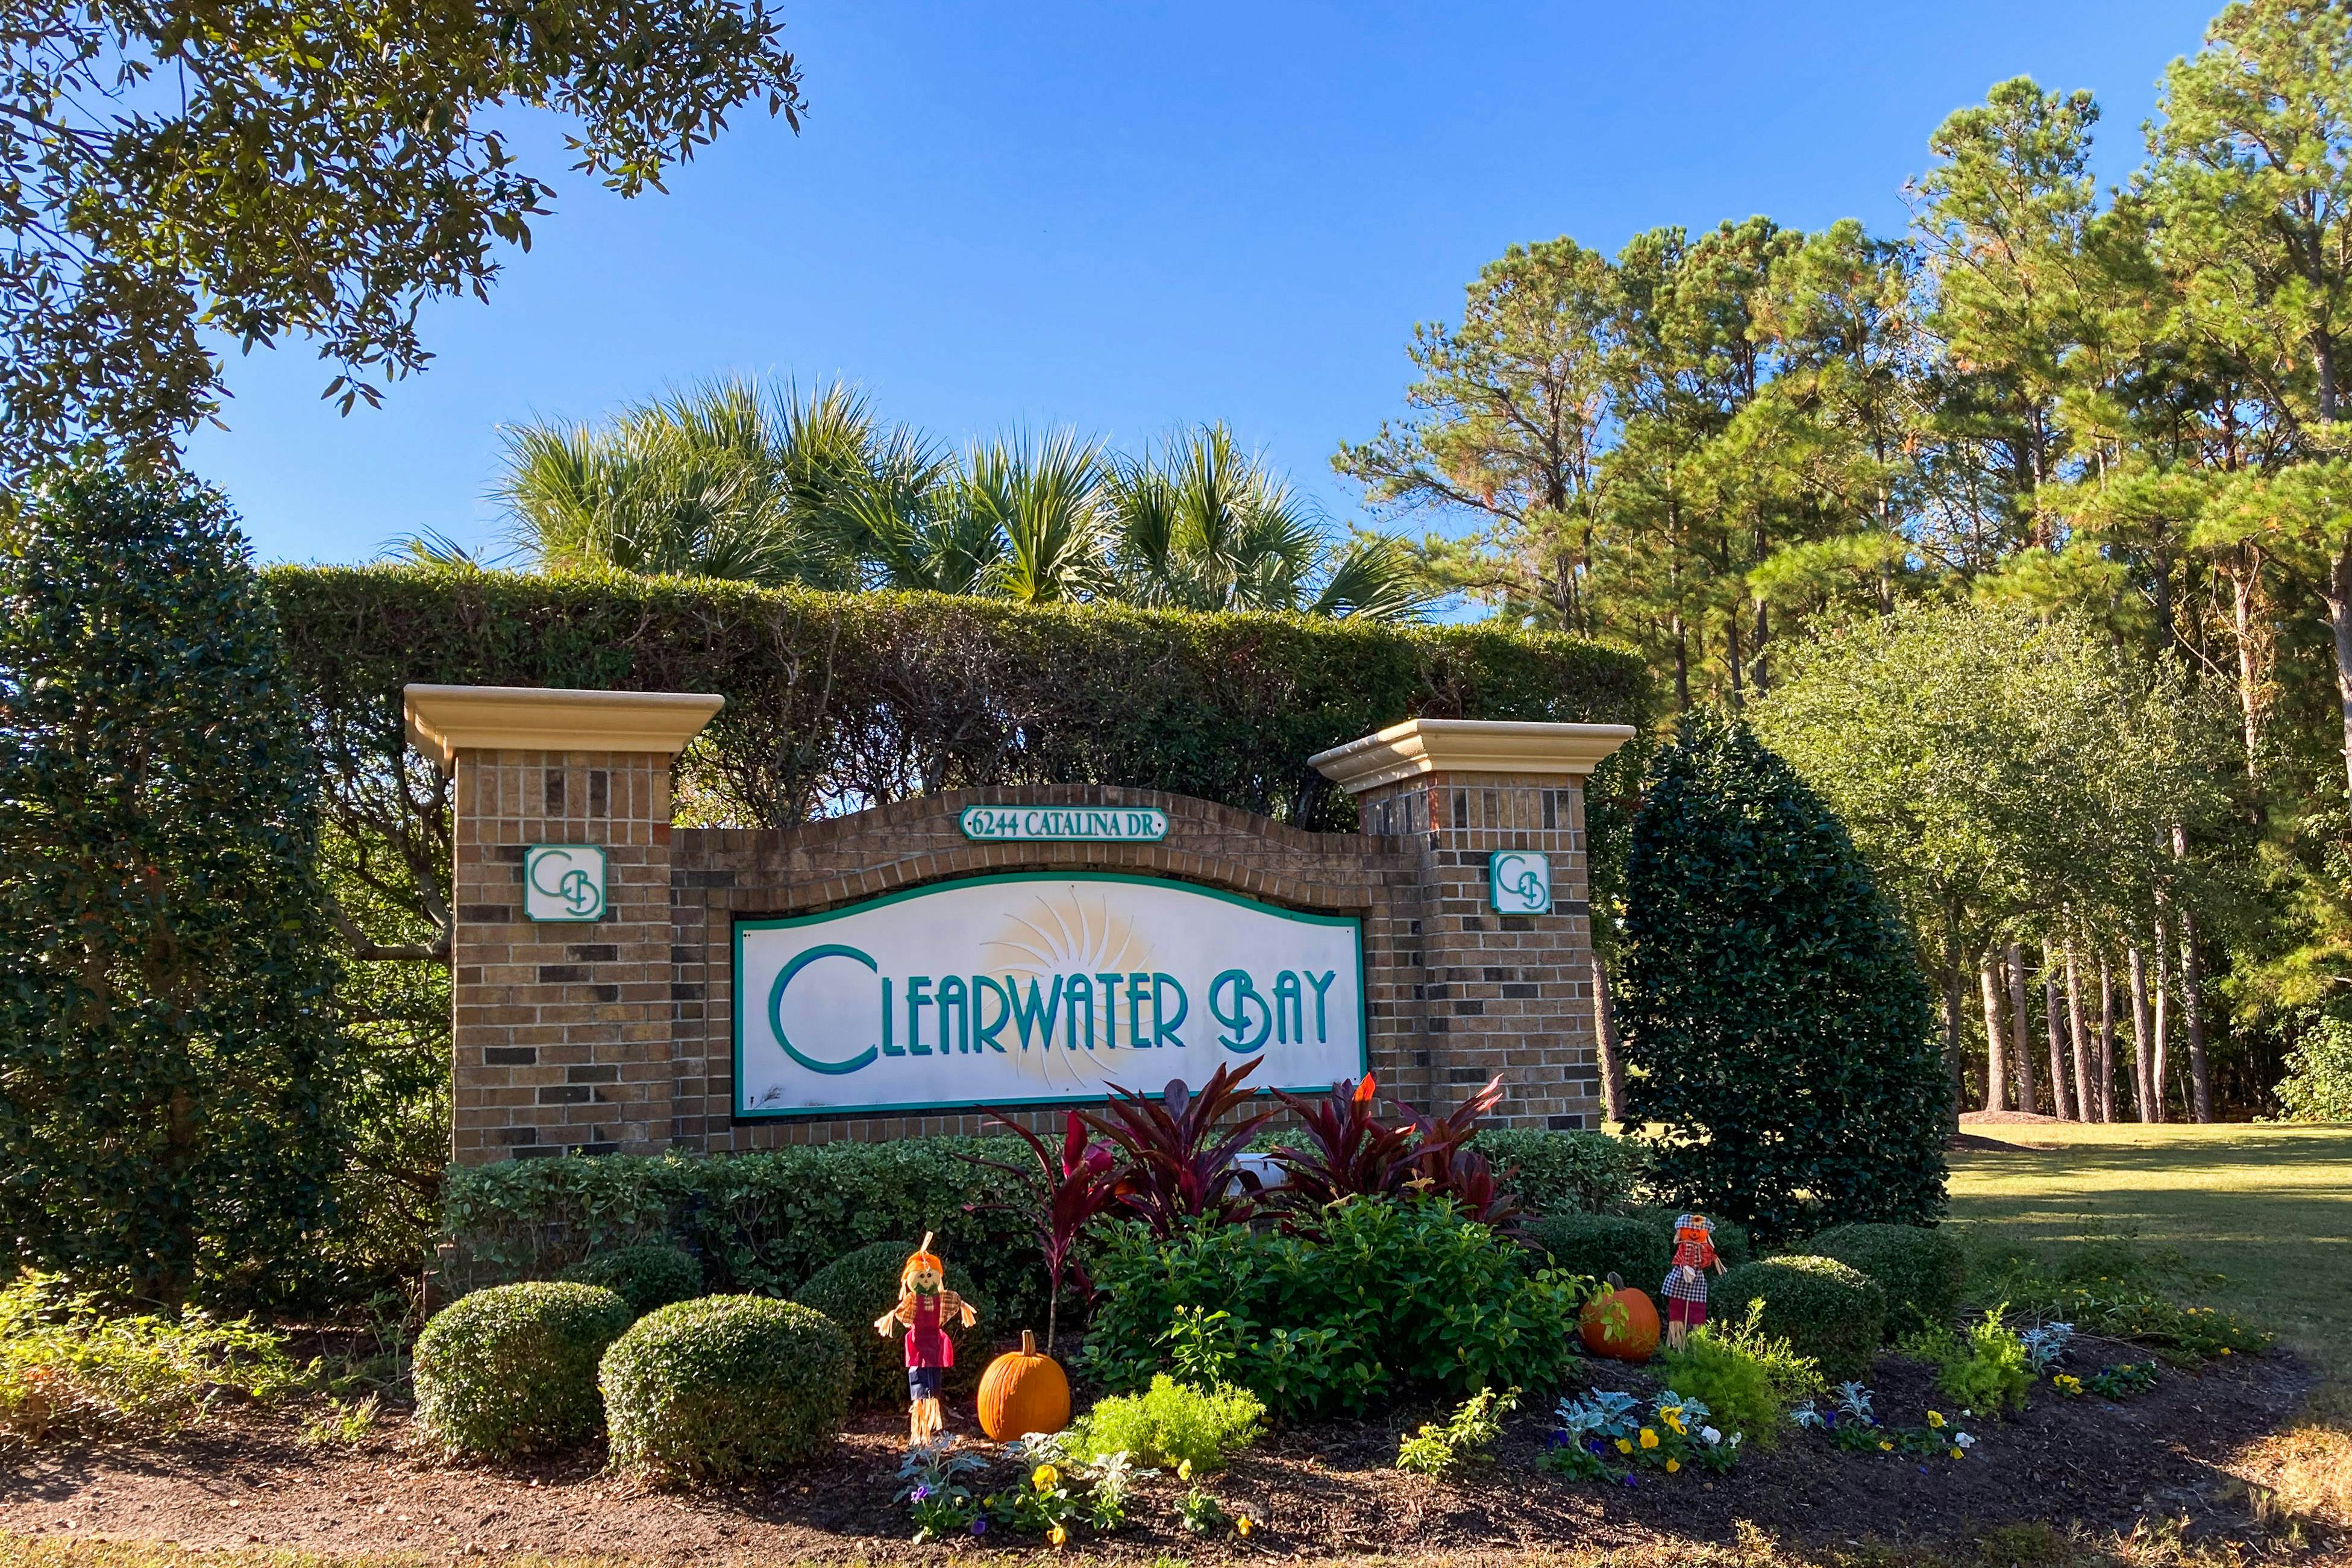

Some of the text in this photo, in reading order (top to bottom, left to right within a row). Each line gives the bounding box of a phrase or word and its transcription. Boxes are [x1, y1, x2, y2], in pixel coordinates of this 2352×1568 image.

[973, 811, 1018, 836] 6244
[1026, 811, 1123, 836] CATALINA
[768, 944, 1337, 1075] CLEARWATER BAY
